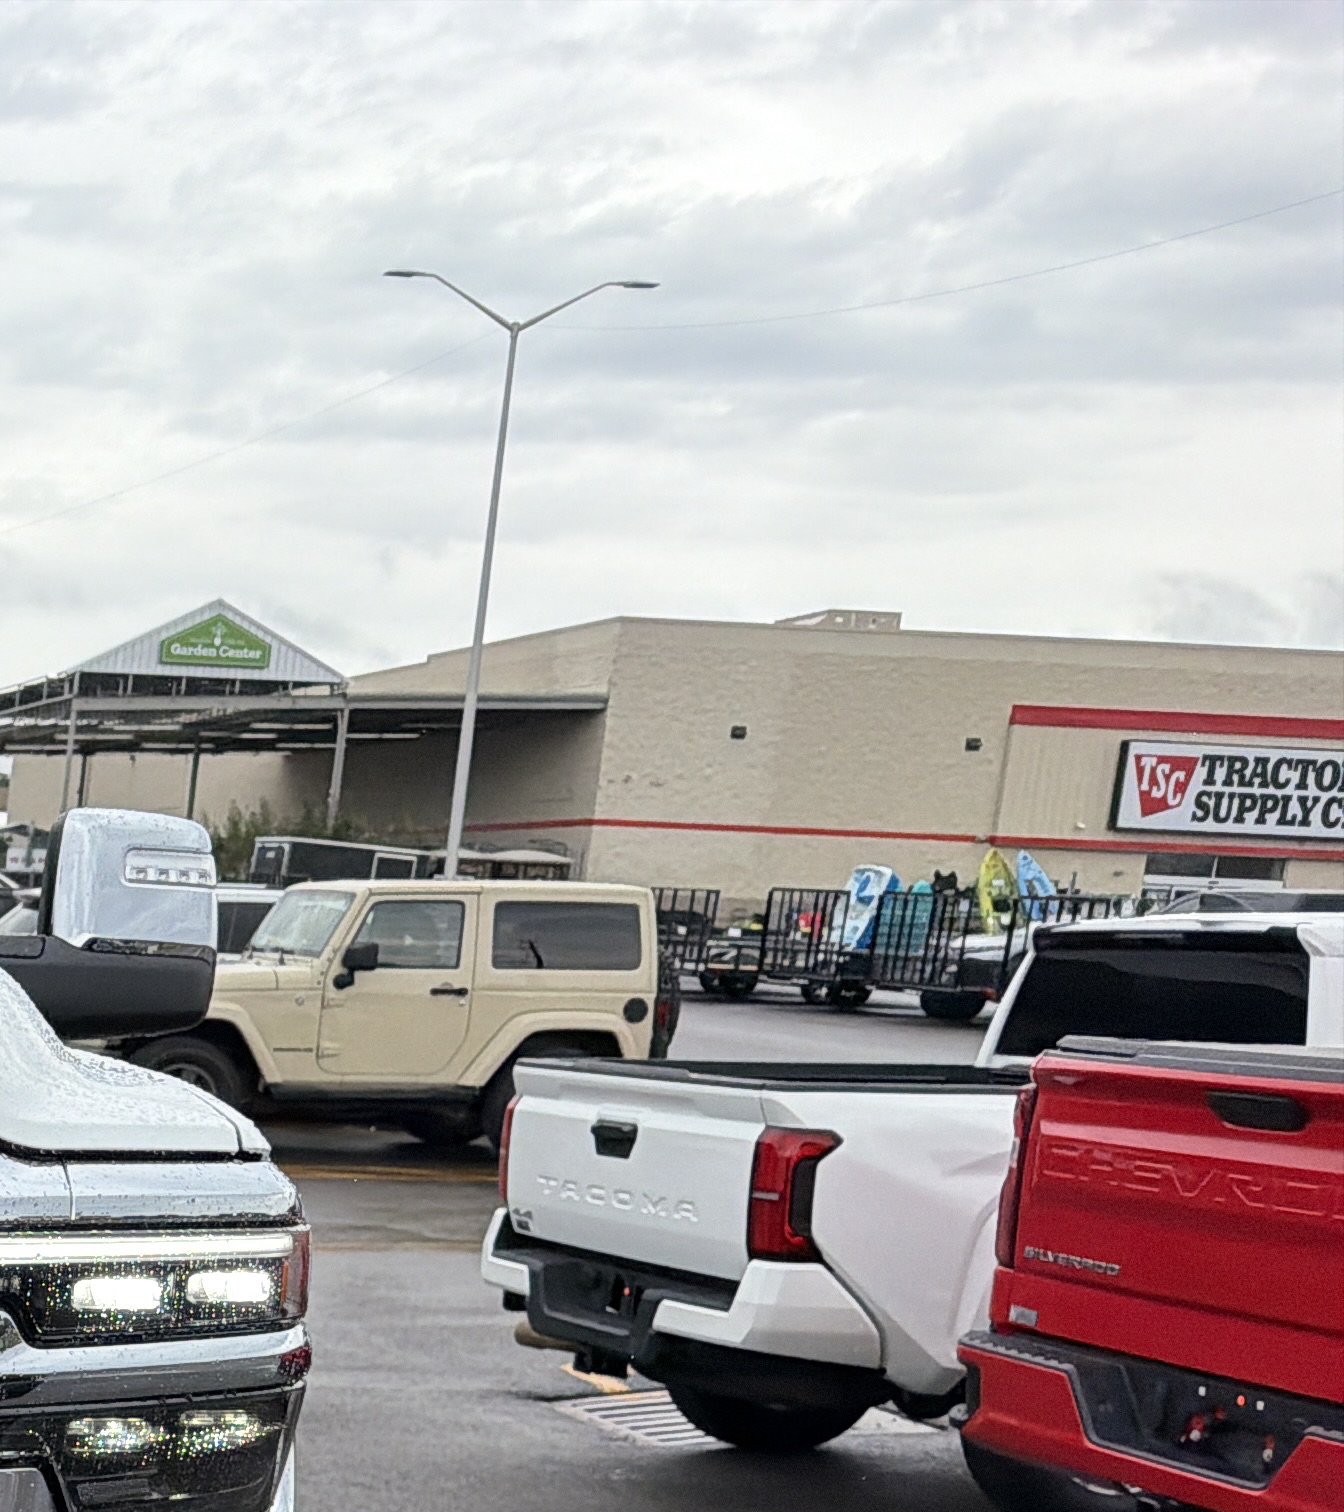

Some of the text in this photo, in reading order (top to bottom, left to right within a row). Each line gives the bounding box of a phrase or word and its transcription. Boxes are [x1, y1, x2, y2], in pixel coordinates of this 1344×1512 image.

[170, 643, 263, 659] Garden Center
[1140, 756, 1186, 806] TSC
[1200, 754, 1344, 792] TRACTO
[1190, 790, 1321, 827] SUPPLY
[536, 1175, 699, 1223] TACOMA
[1041, 1145, 1344, 1221] CHEVRO
[1024, 1246, 1121, 1276] SILVERADO
